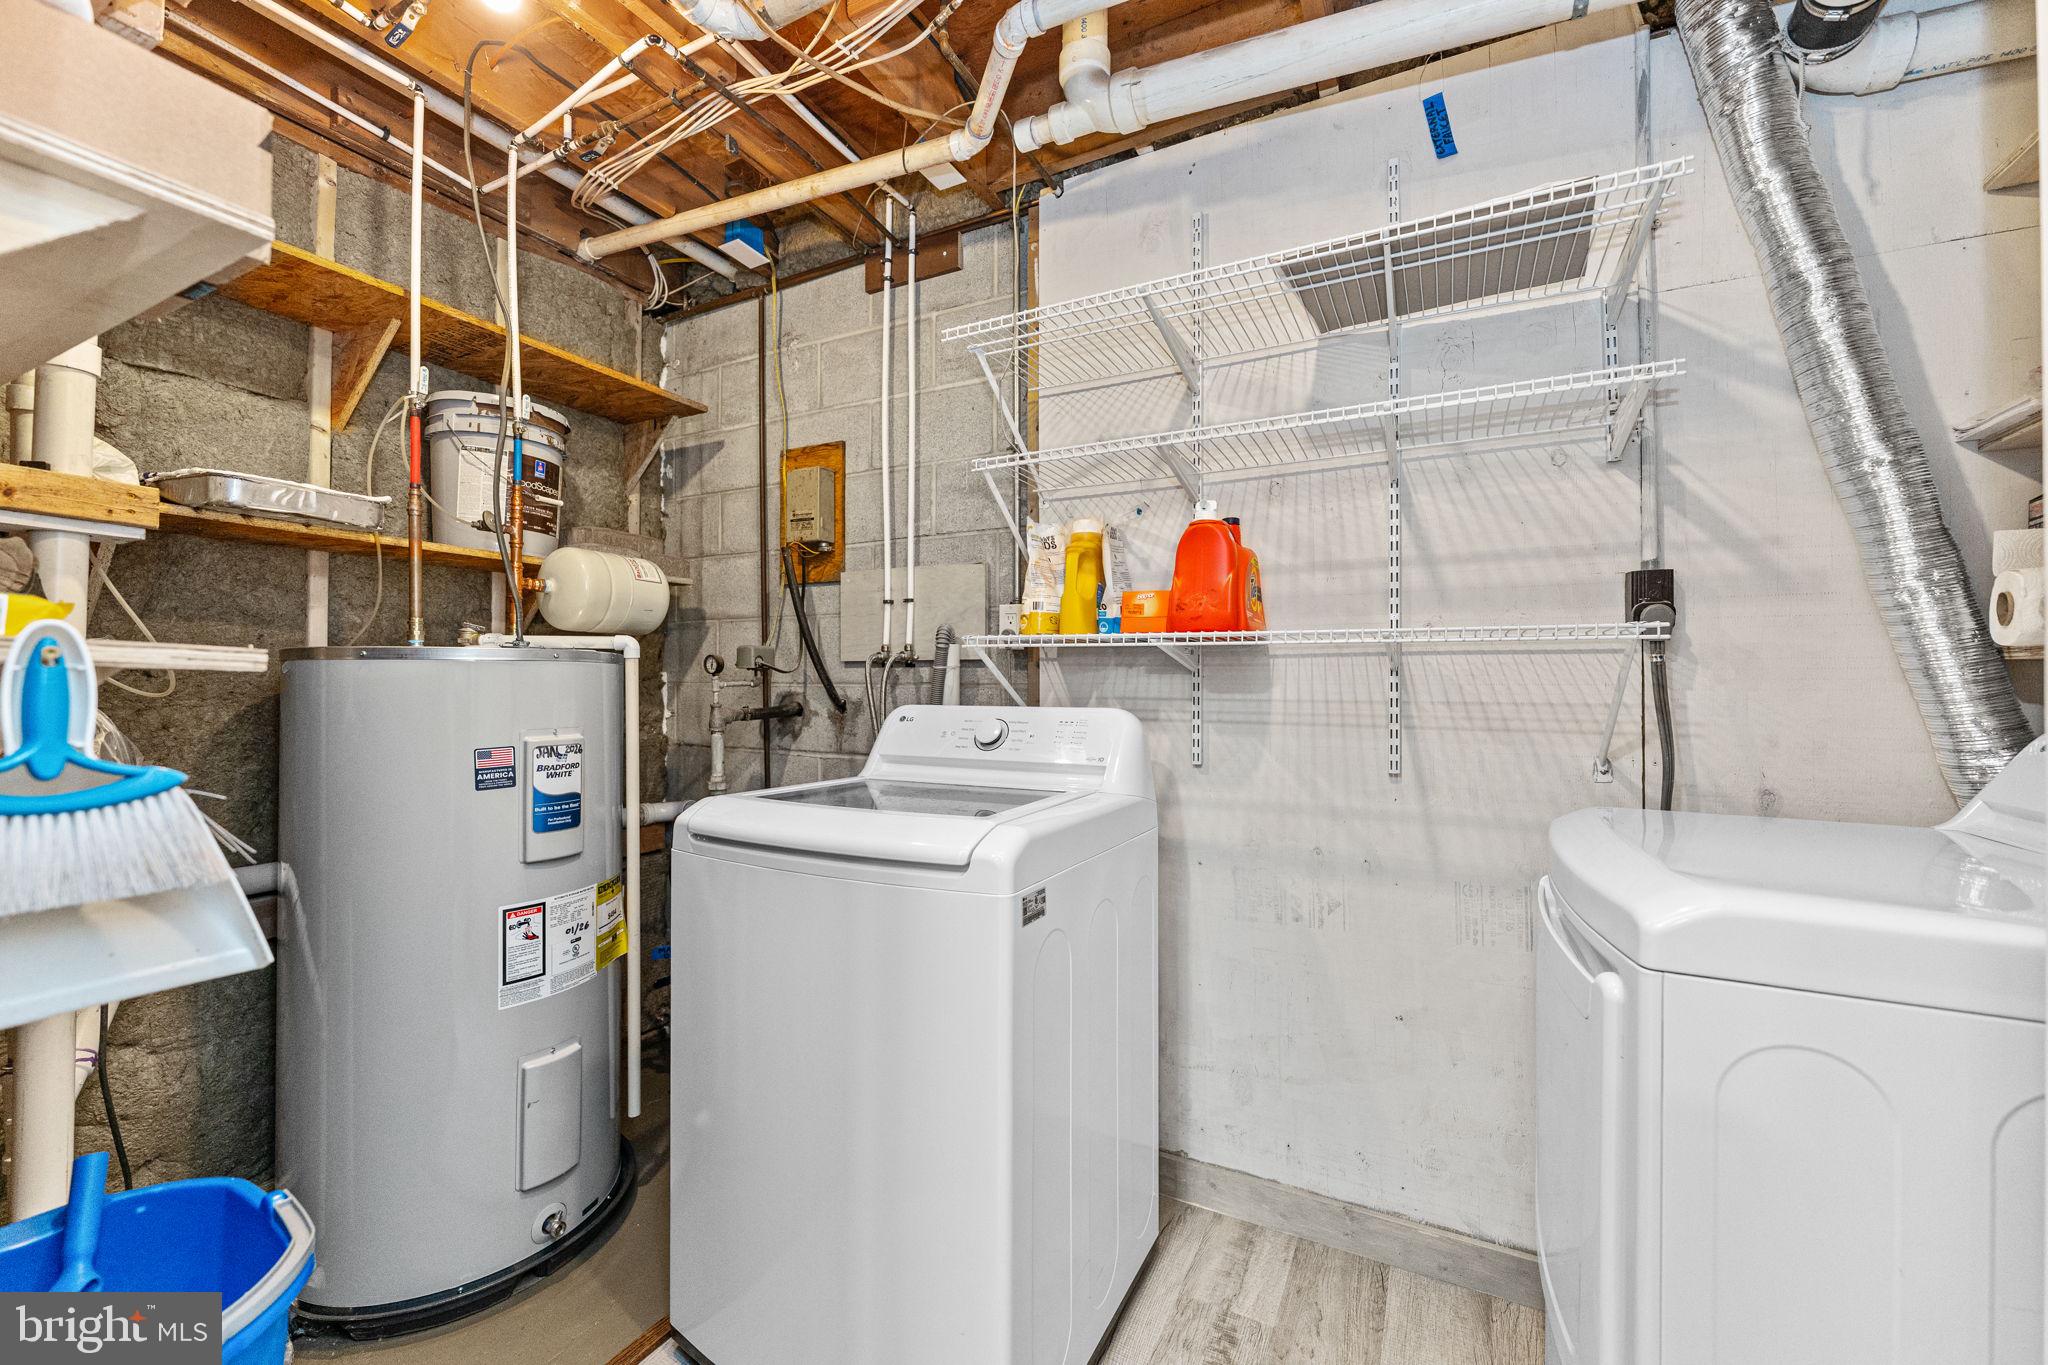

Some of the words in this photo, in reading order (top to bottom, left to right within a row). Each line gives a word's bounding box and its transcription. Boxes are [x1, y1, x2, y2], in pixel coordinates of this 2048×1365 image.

[1966, 53, 1994, 65] PIPE
[1424, 101, 1446, 155] EXTERNAL
[535, 744, 559, 759] JAN
[535, 761, 580, 773] BRADFORD
[476, 771, 514, 781] AMERICA
[545, 770, 574, 779] WHITE
[516, 908, 538, 917] DANGER
[565, 921, 590, 935] 01/26
